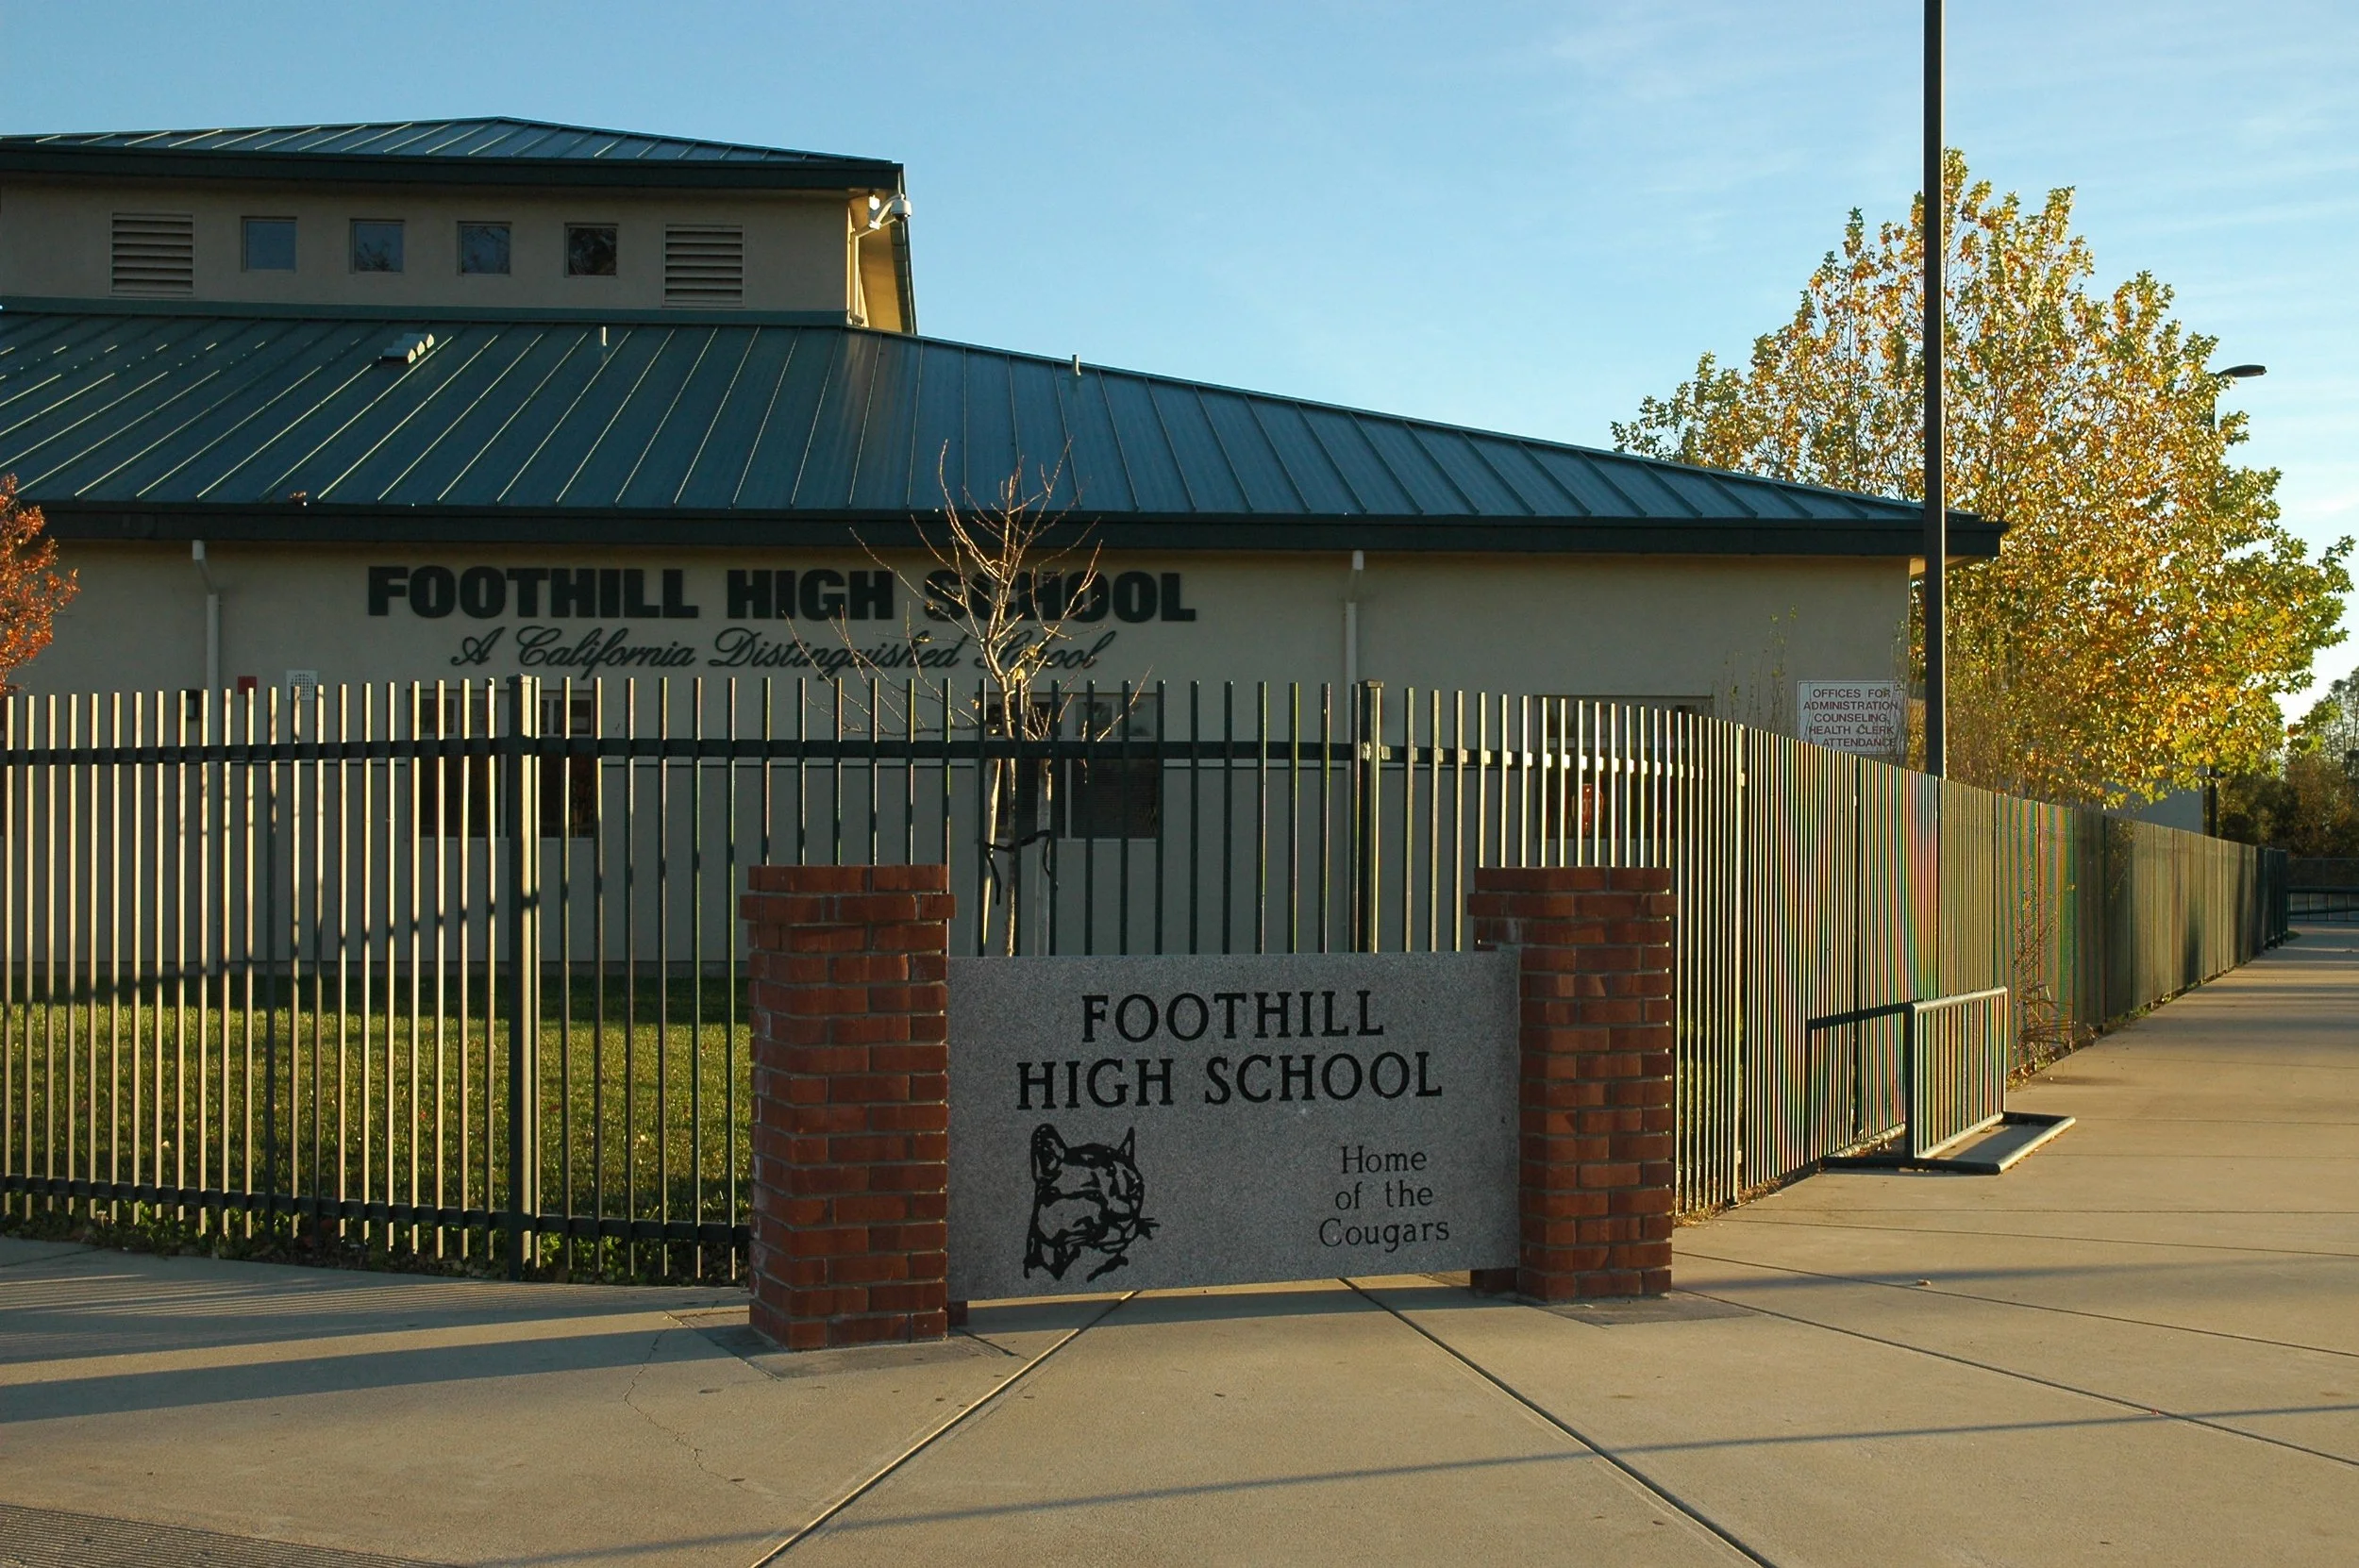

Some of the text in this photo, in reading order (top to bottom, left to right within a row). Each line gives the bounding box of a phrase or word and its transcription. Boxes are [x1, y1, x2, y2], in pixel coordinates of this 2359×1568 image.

[368, 566, 1196, 623] FOOTHILL HIGH SCHOOL
[450, 626, 507, 666] A
[515, 626, 696, 680] California
[709, 626, 970, 681] Distinguished
[1803, 701, 1899, 710] ADMINISTRATION
[1813, 689, 1891, 698] OFFICES FOR
[1809, 725, 1894, 735] HEALTH CLERK
[1823, 738, 1896, 747] ATTENDANCE
[1081, 990, 1385, 1043] FOOTHILL
[1016, 1052, 1443, 1110] HIGH SCHOOL
[1341, 1145, 1428, 1174] Home
[1335, 1179, 1433, 1210] of the
[1318, 1218, 1450, 1253] Cougars
